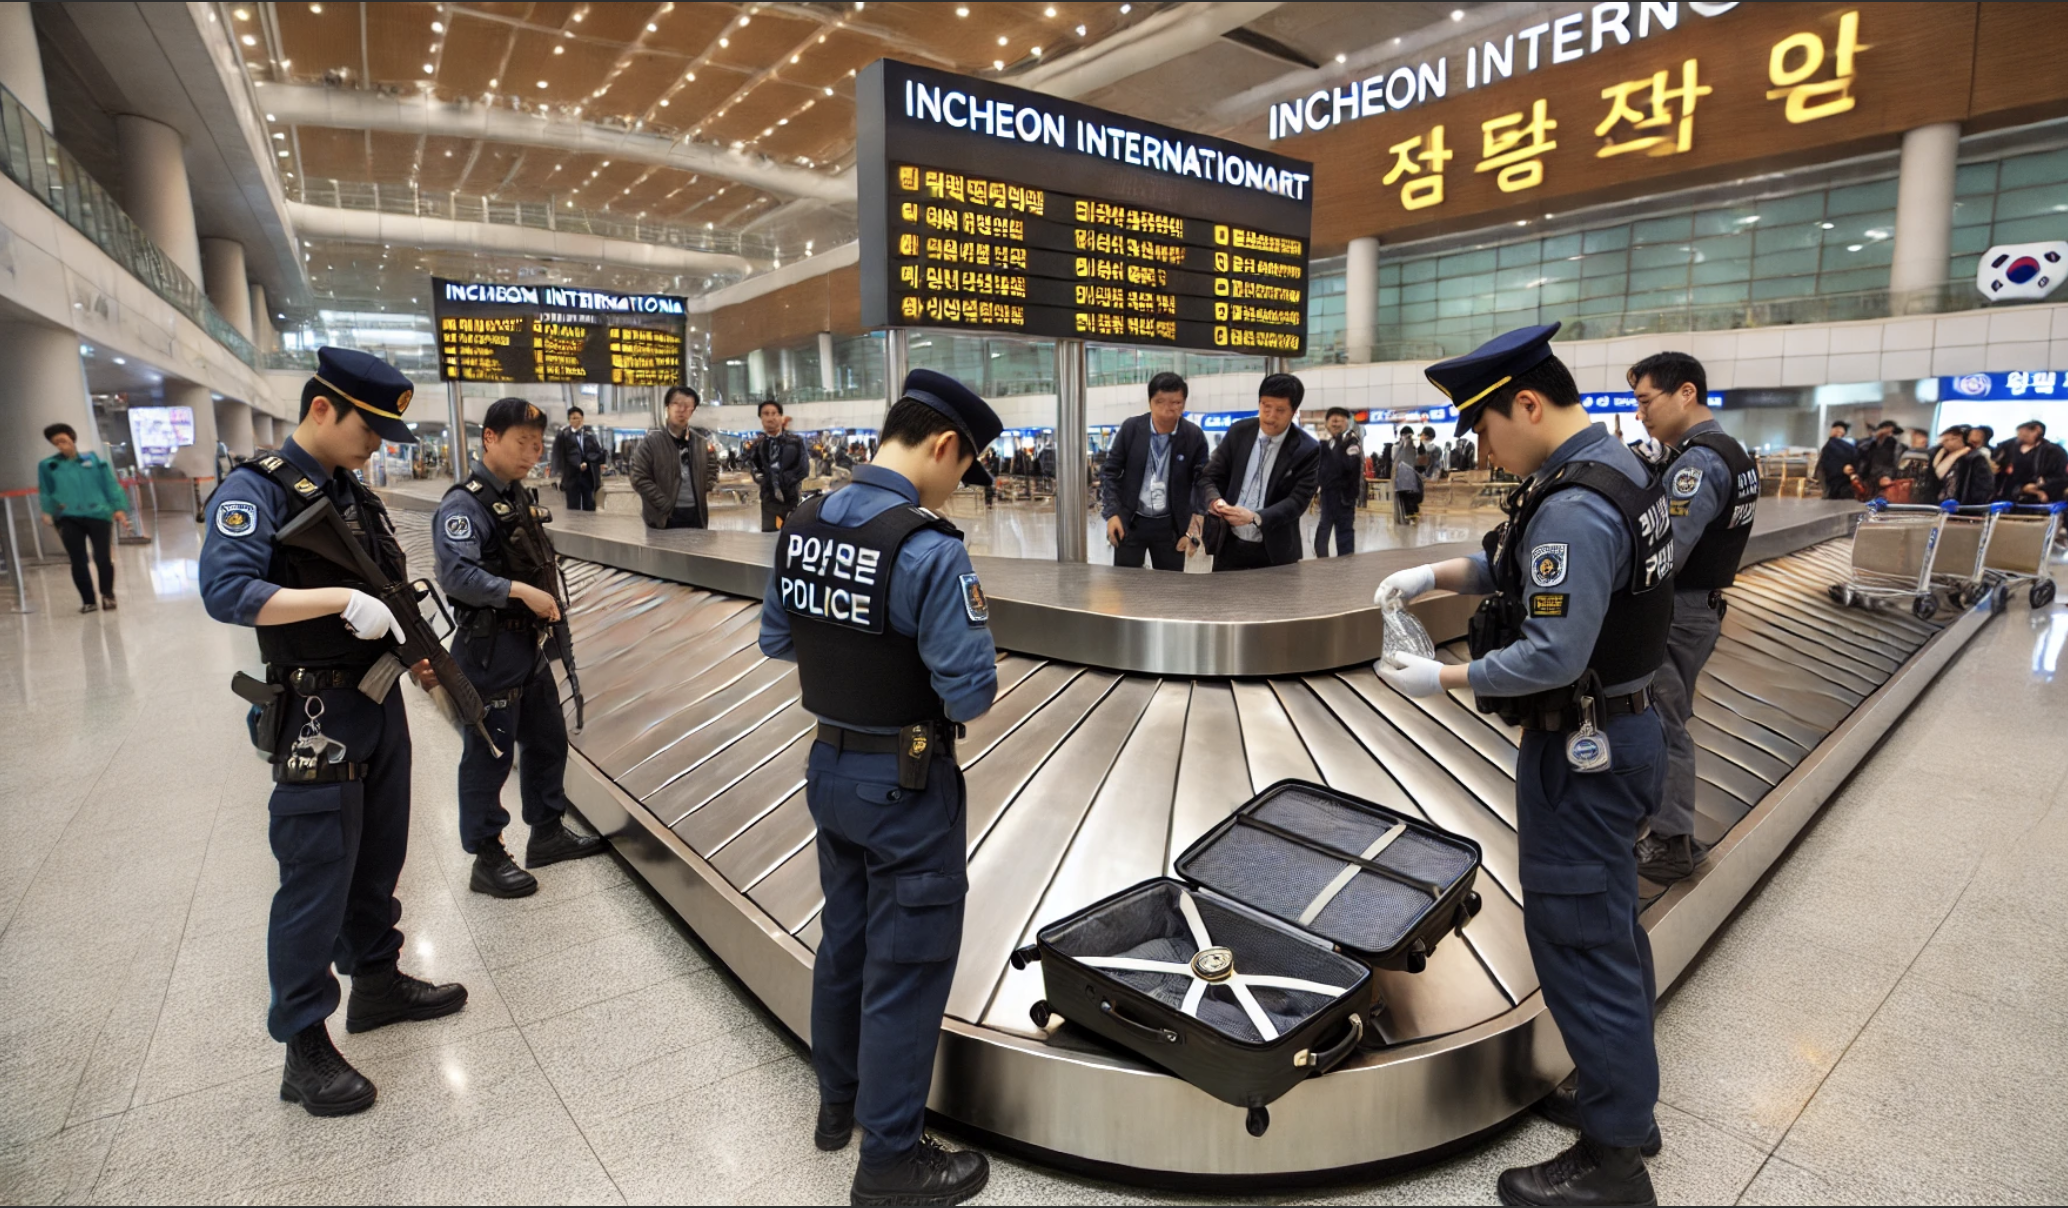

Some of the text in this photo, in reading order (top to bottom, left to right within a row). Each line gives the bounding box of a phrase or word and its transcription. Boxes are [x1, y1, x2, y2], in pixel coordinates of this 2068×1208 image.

[905, 79, 1066, 148] INCHEON
[1269, 56, 1447, 140] INCHEON
[781, 576, 871, 626] POLICE
